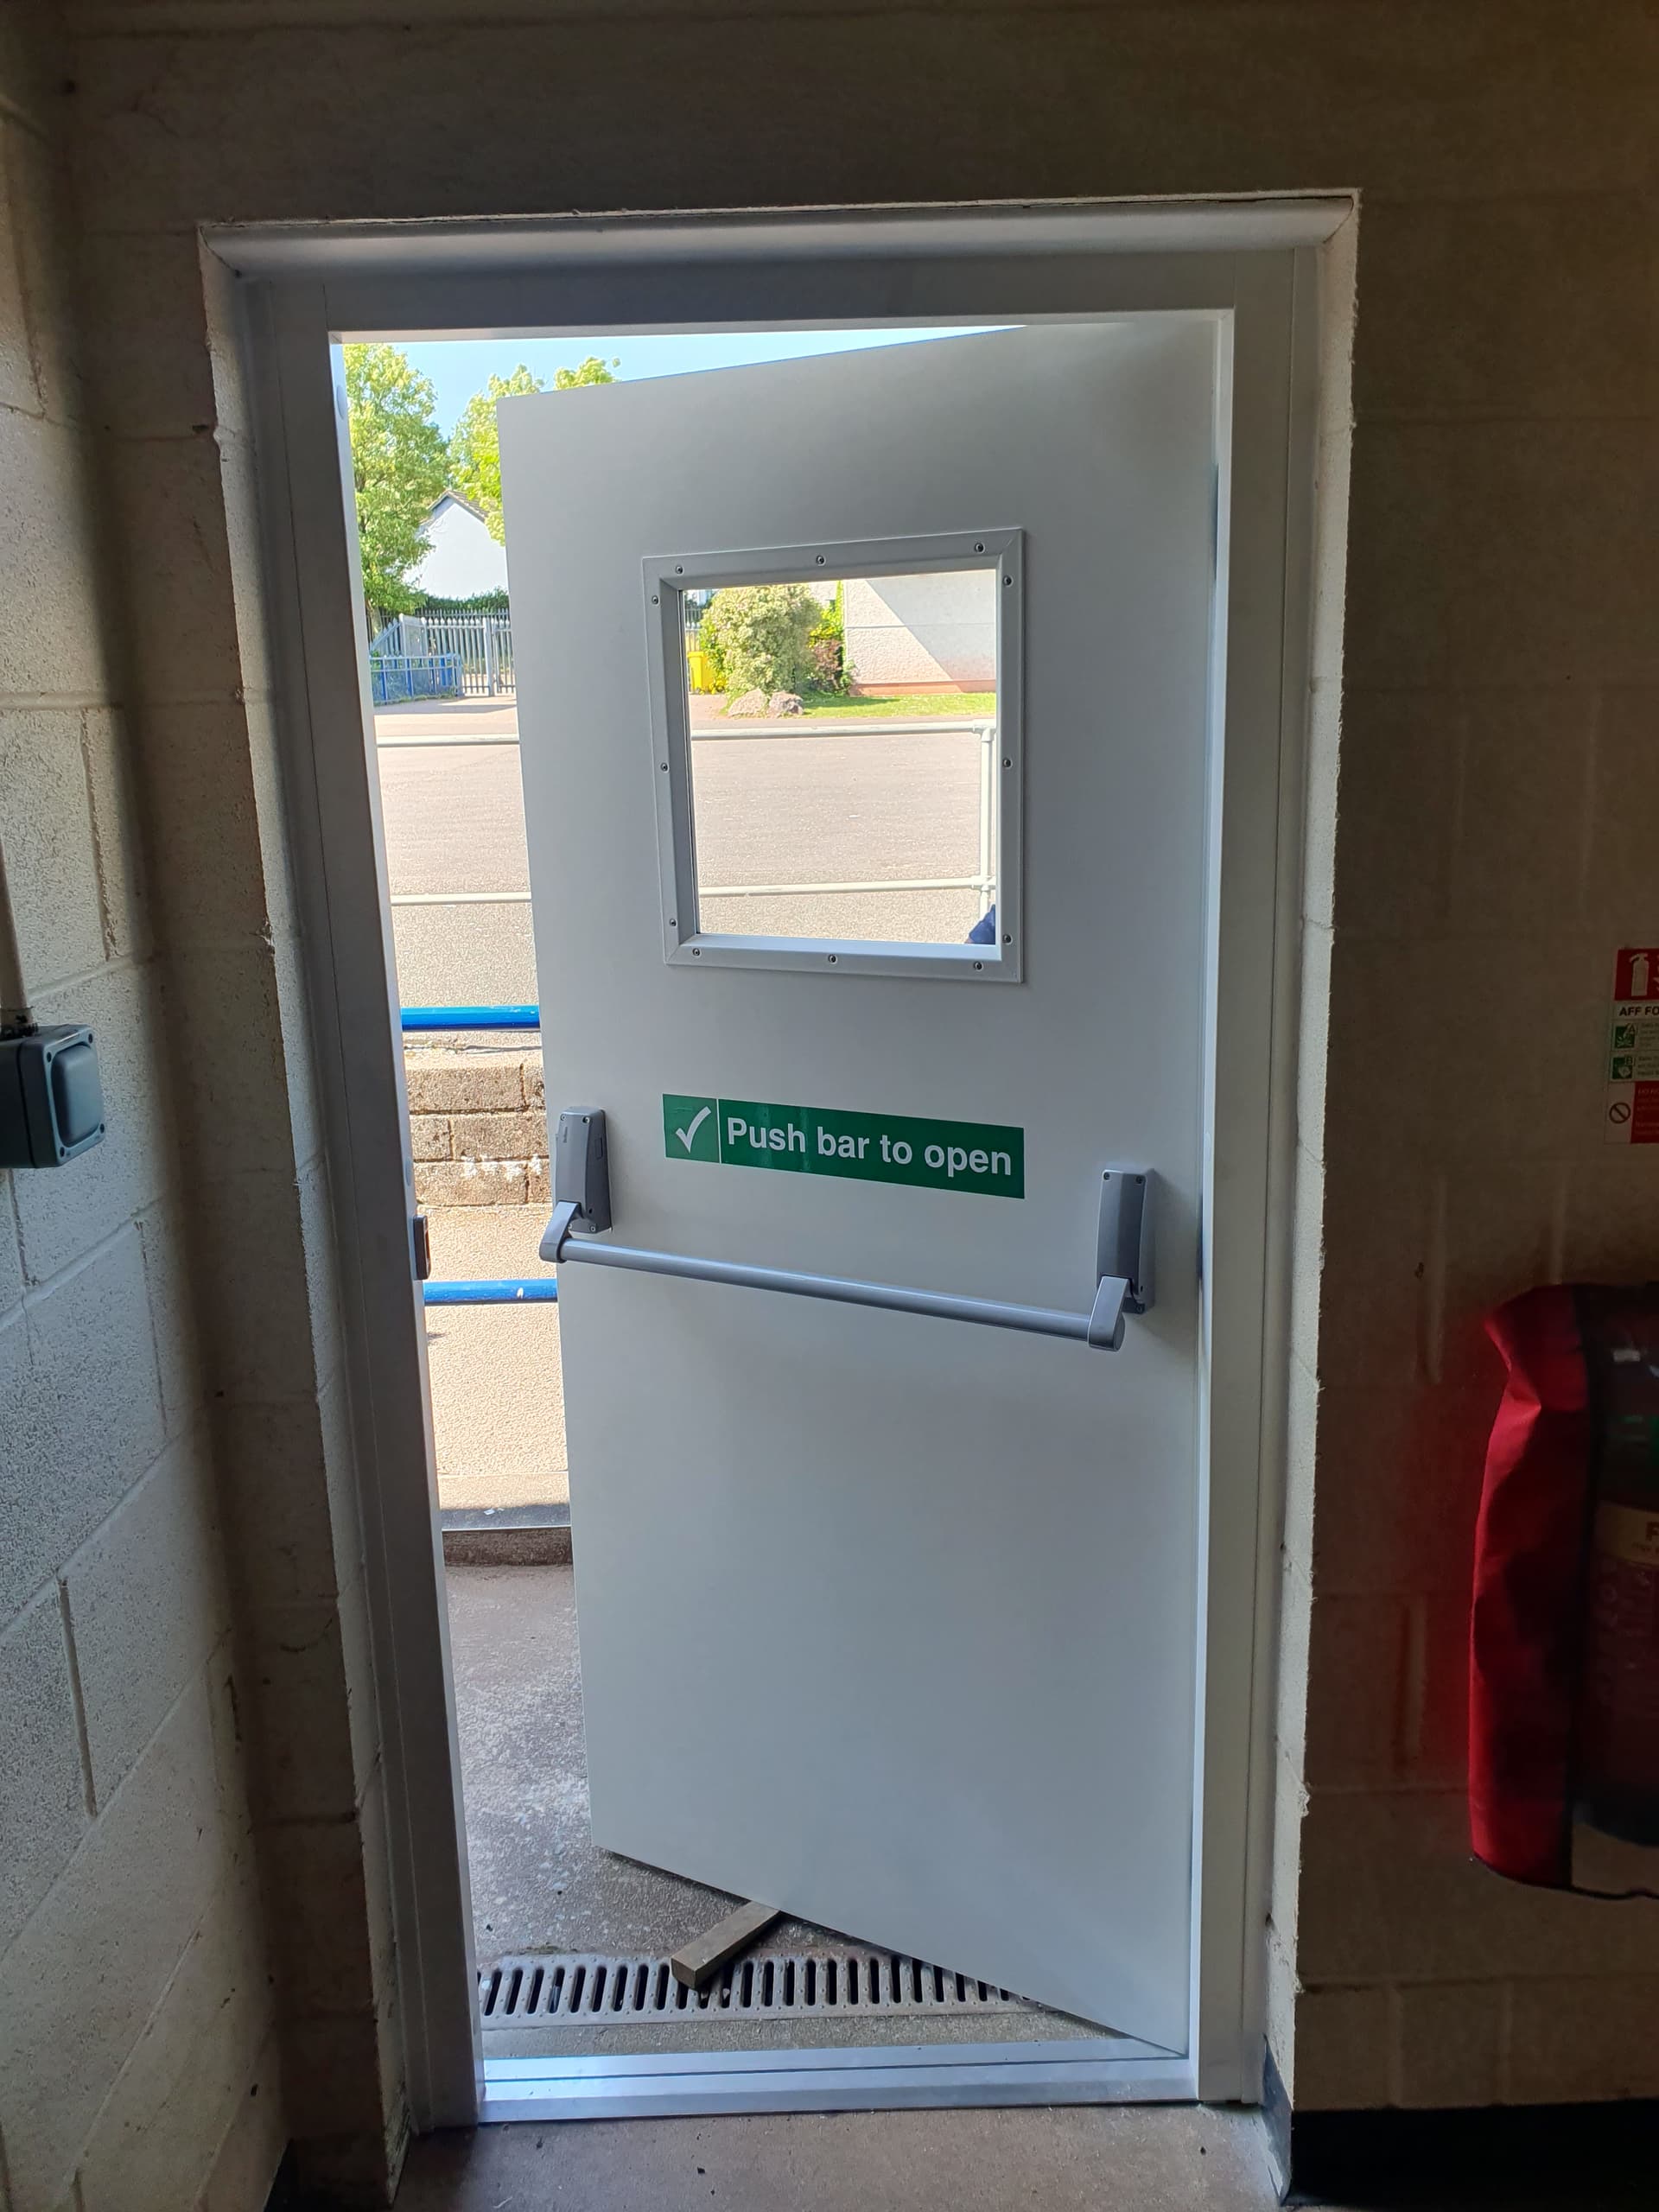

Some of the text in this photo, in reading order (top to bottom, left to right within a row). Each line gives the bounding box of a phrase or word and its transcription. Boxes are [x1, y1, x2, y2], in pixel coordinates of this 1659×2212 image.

[728, 1117, 1011, 1178] Push bar to open
